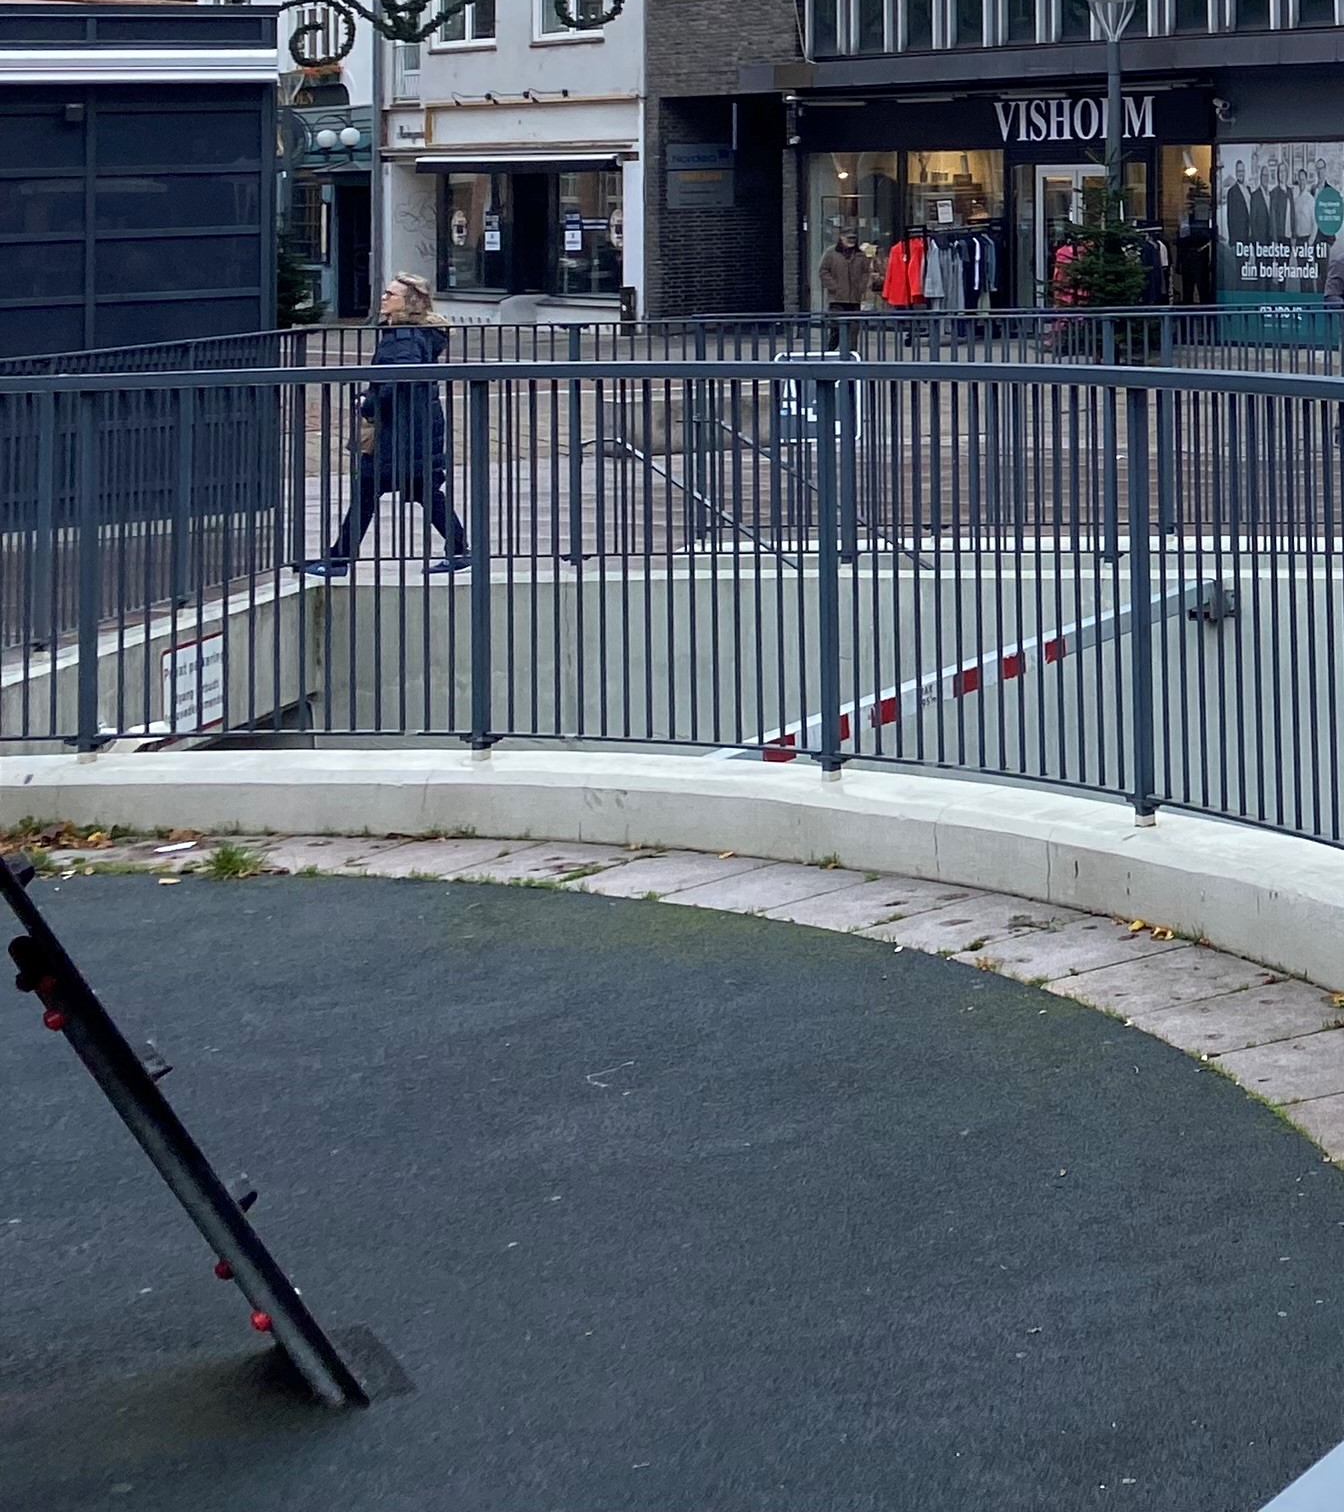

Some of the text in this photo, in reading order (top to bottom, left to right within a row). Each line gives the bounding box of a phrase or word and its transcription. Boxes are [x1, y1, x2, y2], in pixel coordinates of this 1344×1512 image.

[1236, 241, 1328, 262] Det bedste valg til
[1241, 262, 1319, 281] din bolighandel
